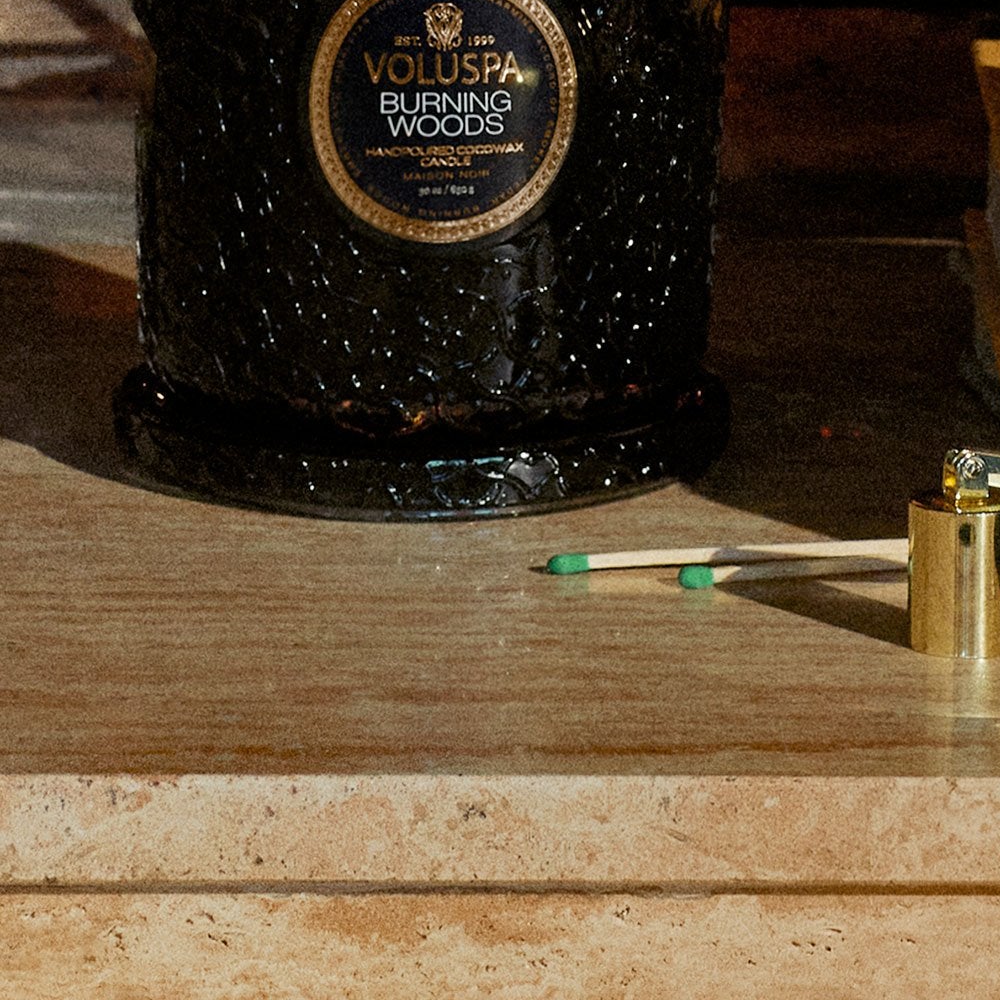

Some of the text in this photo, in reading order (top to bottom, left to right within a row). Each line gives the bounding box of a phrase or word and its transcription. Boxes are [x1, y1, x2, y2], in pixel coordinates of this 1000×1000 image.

[468, 35, 496, 47] 1999
[363, 50, 524, 85] VOLUSPA
[380, 90, 512, 115] BURNING
[387, 113, 504, 138] WOODS
[420, 155, 472, 168] CANDLE
[403, 169, 491, 181] MAISON NOIR
